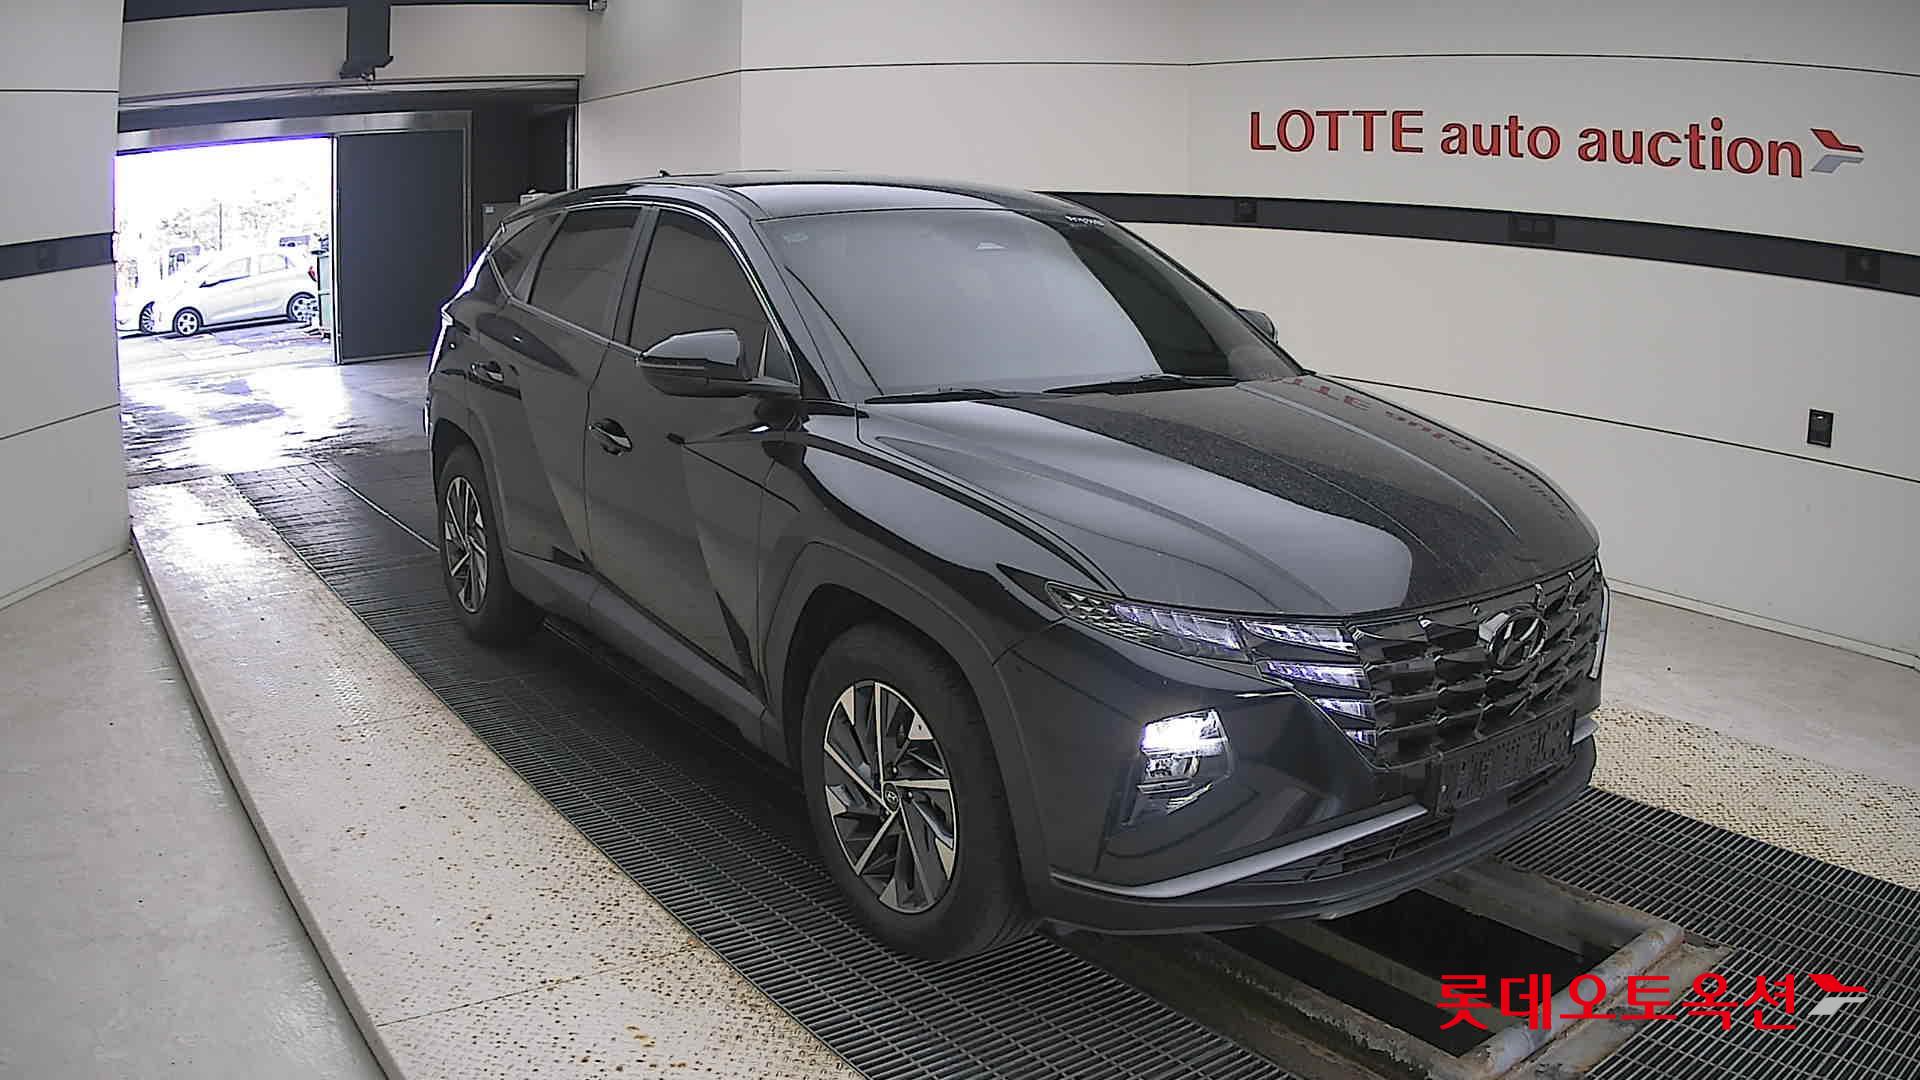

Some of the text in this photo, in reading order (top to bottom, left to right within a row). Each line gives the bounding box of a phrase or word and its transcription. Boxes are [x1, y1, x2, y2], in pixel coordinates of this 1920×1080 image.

[1250, 110, 1803, 178] LOTTE auto auction
